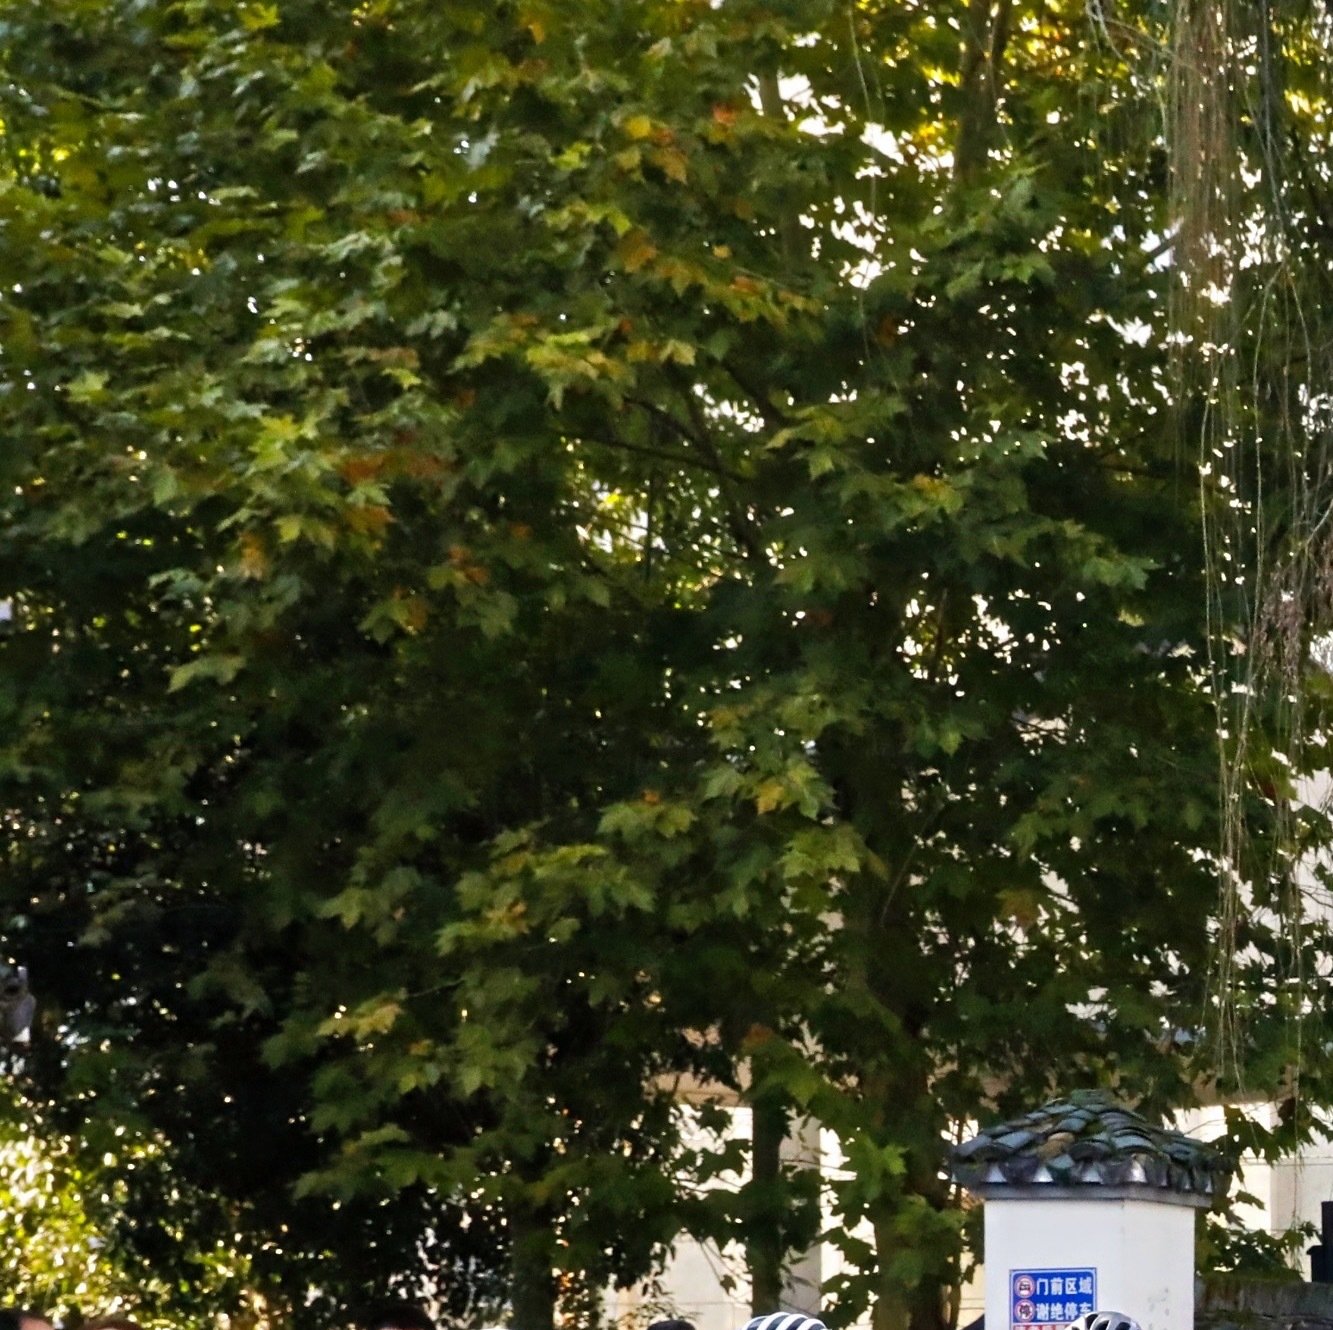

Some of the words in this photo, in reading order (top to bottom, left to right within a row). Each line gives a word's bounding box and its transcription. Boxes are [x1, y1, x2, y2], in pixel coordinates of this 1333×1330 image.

[1036, 1277, 1093, 1295] 门前区域
[1036, 1302, 1092, 1320] 谢绝停车
